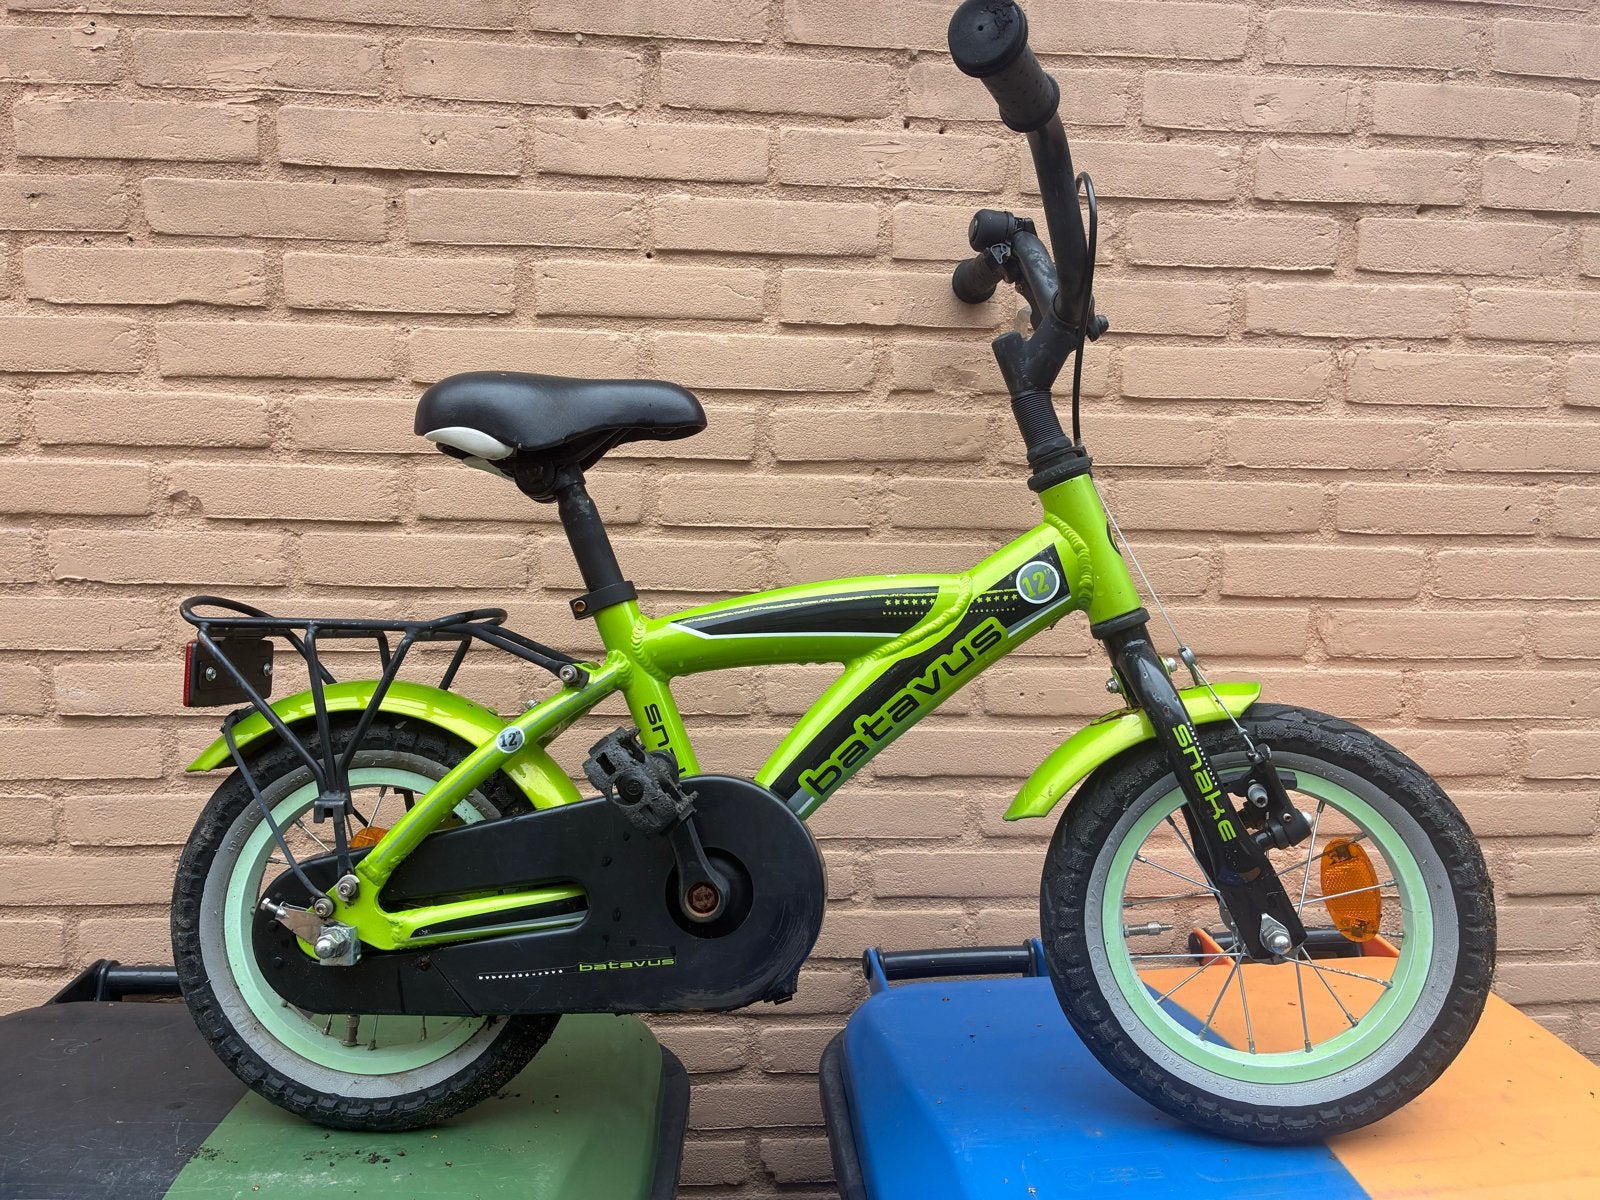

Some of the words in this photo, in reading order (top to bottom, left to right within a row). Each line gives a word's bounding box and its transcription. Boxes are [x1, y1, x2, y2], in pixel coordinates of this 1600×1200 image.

[803, 621, 1005, 797] batavus
[1172, 723, 1237, 842] snake
[579, 957, 675, 972] batavus
